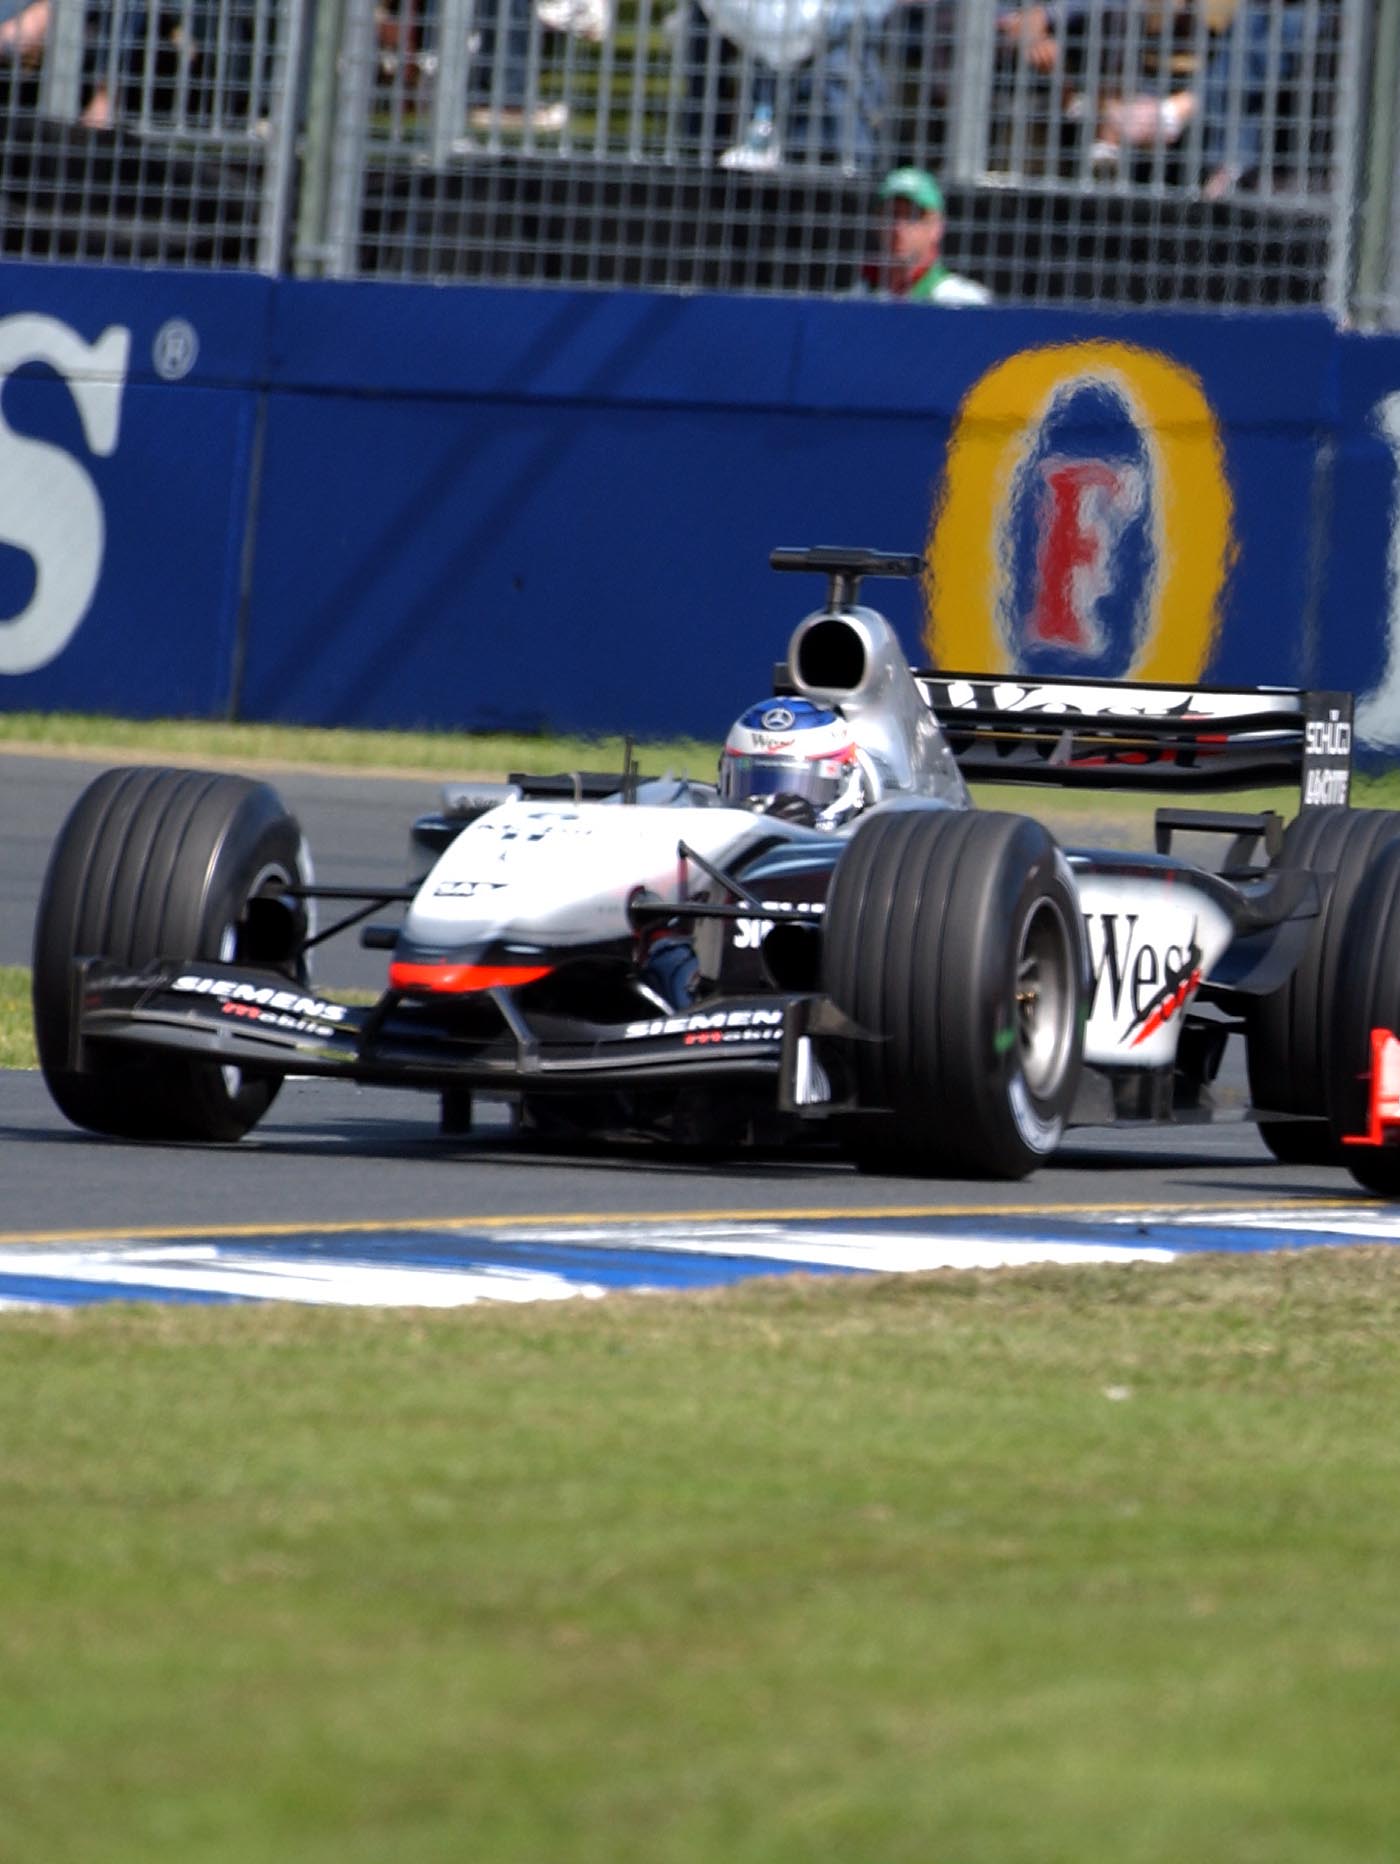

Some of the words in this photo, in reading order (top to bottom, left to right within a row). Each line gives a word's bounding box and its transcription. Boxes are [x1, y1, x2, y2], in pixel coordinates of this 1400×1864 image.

[171, 974, 347, 1021] SIEMENS
[221, 1000, 334, 1037] mobile
[625, 1009, 784, 1039] SIEMEN
[684, 1028, 784, 1045] mobil
